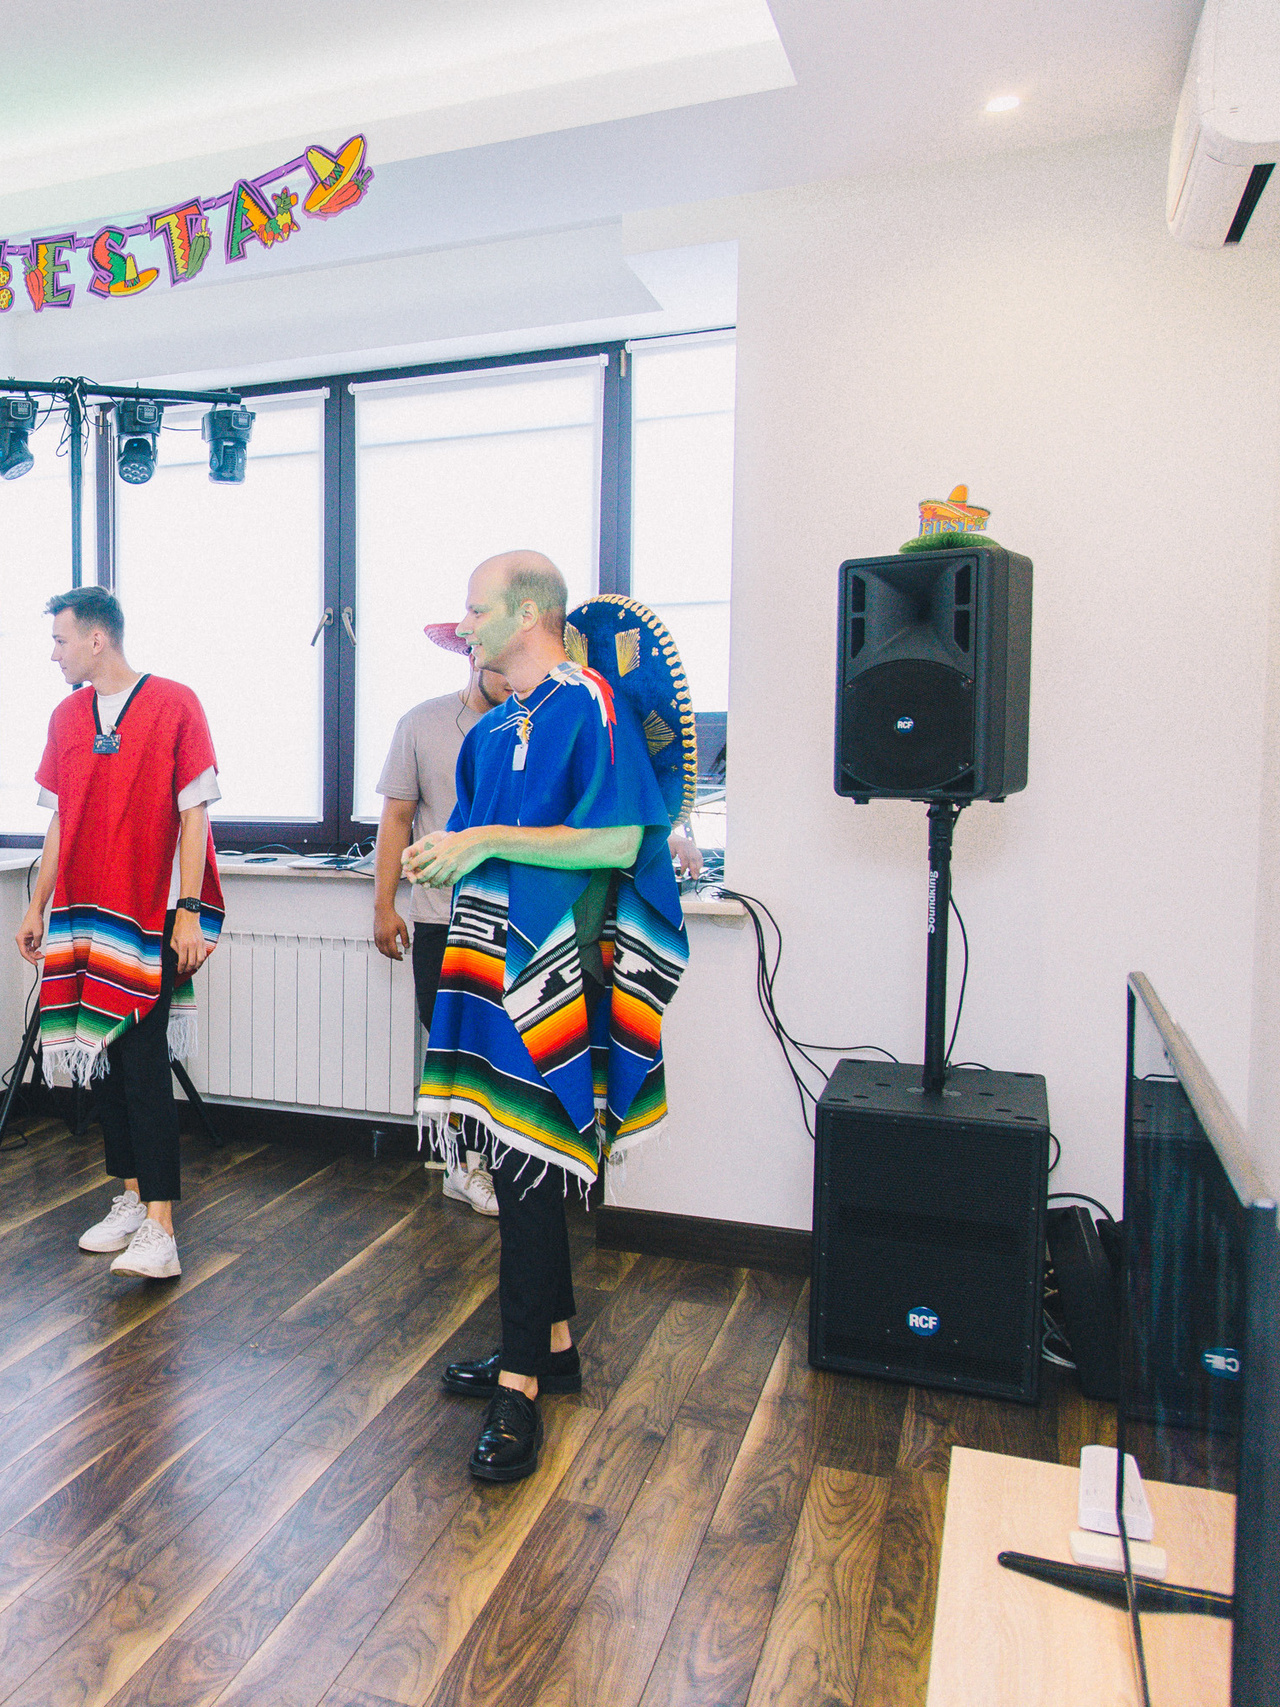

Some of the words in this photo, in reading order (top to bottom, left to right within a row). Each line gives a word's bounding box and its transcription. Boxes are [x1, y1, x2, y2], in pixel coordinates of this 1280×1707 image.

[920, 516, 986, 536] FIESTA
[897, 720, 914, 729] RCF
[909, 1313, 938, 1330] RCF
